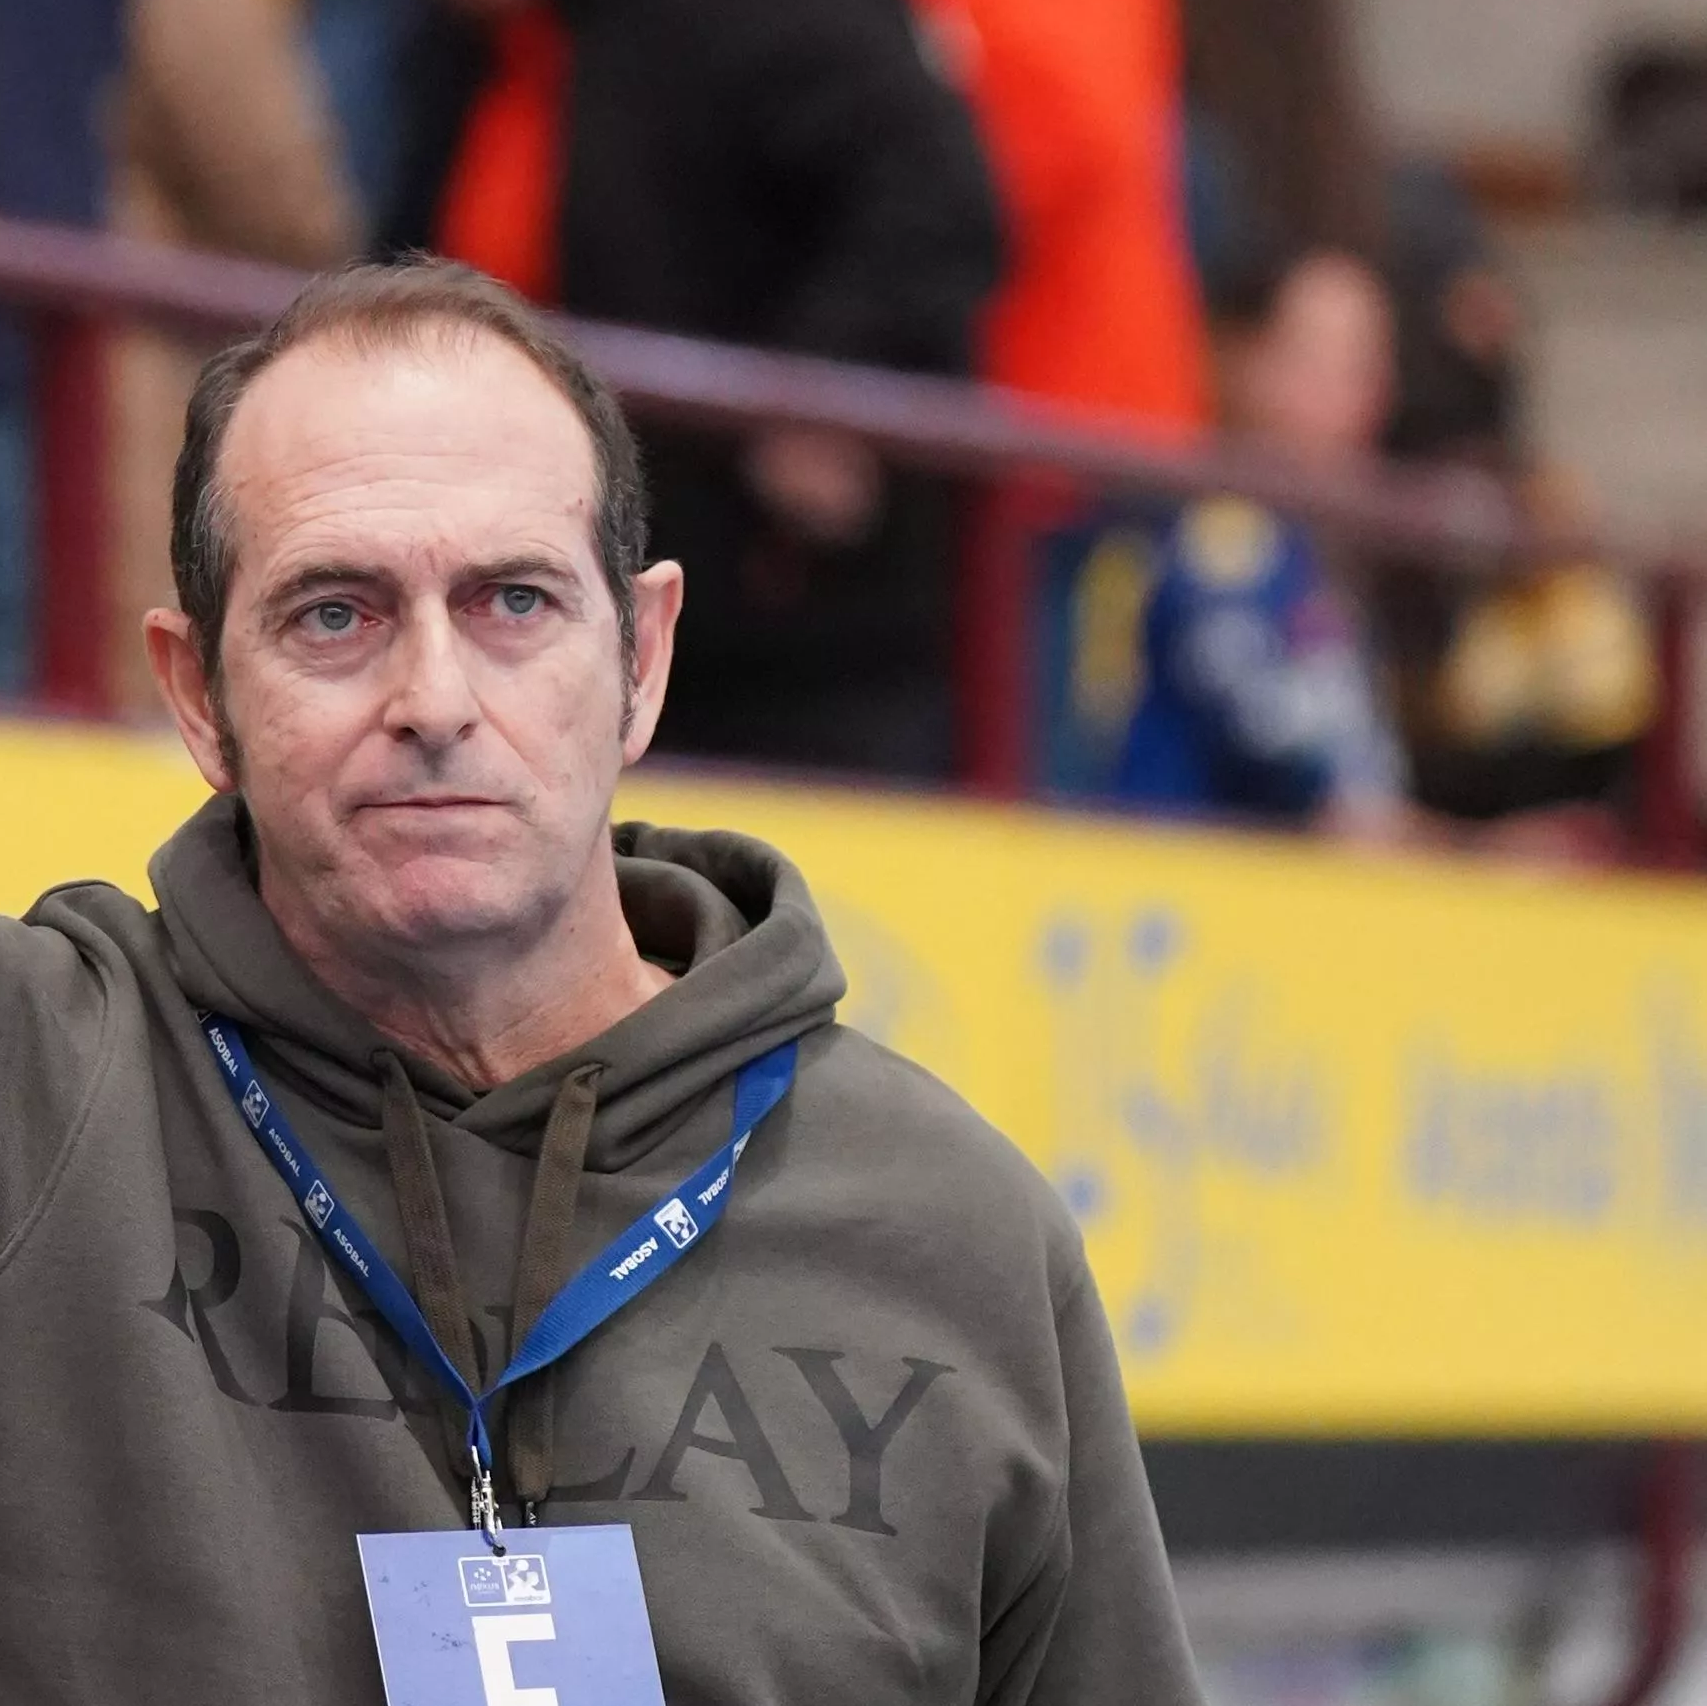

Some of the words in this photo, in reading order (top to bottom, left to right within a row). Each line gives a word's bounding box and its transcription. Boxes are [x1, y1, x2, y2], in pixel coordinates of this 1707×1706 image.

[208, 1026, 239, 1078] ASOBAL
[268, 1127, 301, 1178] ASOBAL
[697, 1166, 730, 1206] ASOBAL
[333, 1227, 371, 1278] ASOBAL
[609, 1236, 660, 1281] ASOBAL
